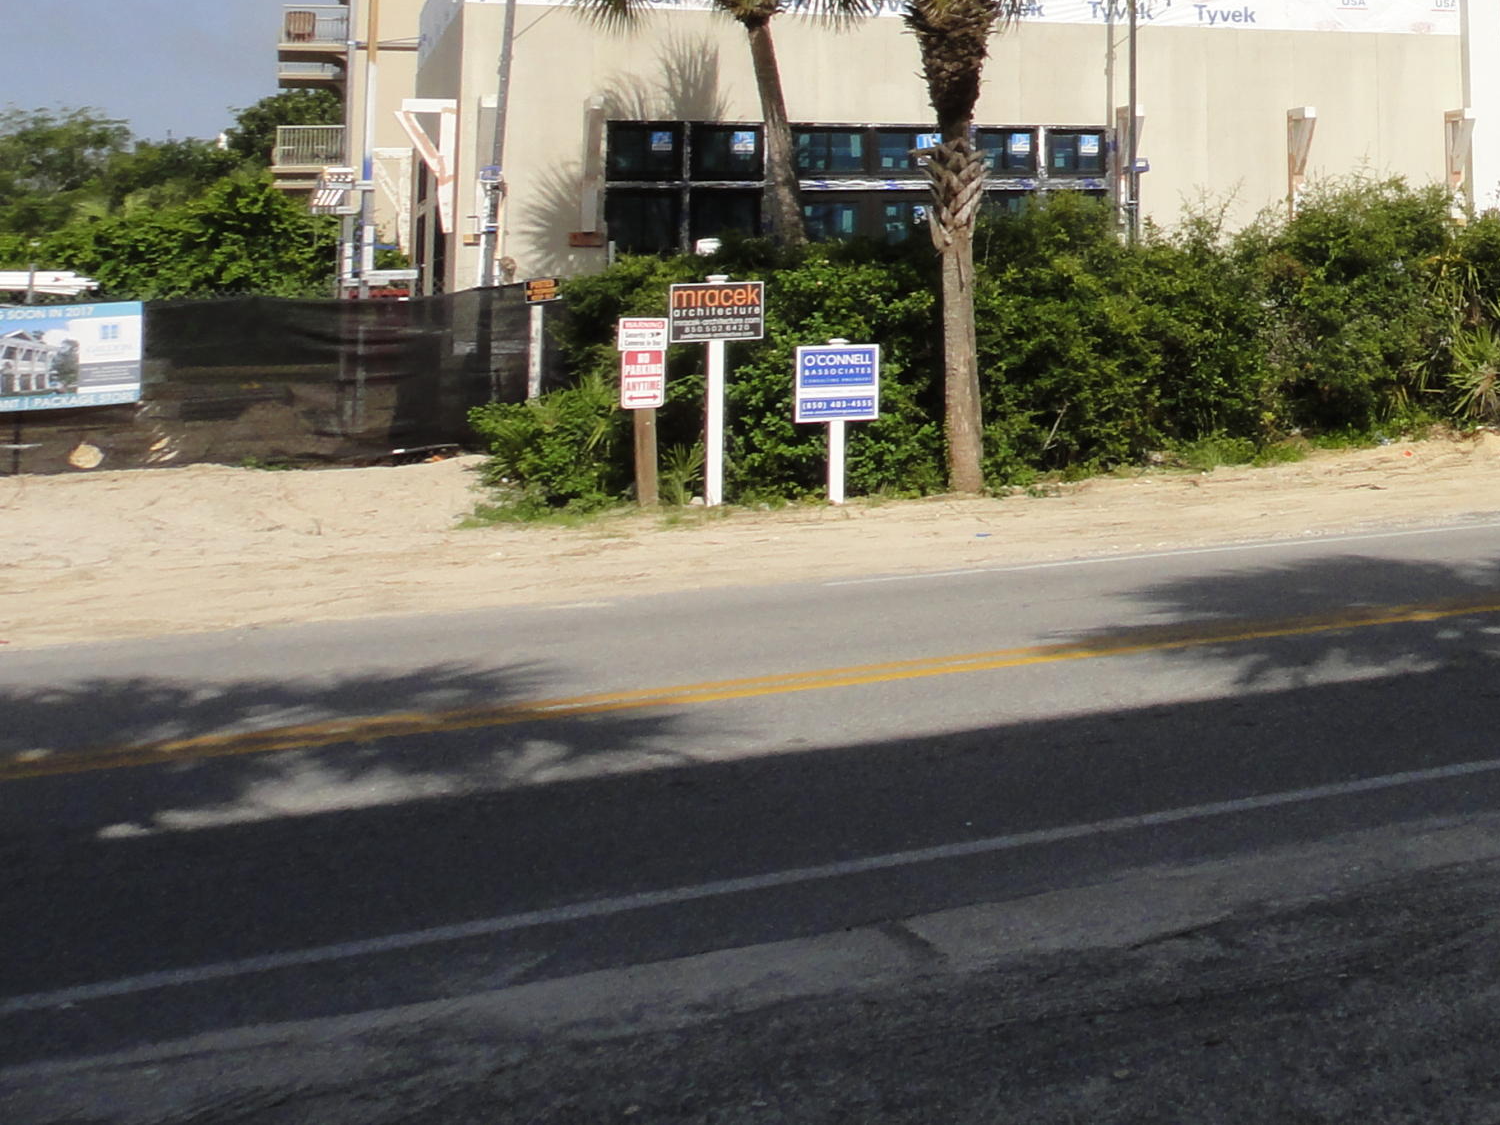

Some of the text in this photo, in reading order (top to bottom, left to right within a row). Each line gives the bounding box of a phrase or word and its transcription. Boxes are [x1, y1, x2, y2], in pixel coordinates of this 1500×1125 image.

[1193, 4, 1256, 25] Tyvek
[673, 285, 760, 307] mracek
[7, 309, 46, 320] SOON
[65, 306, 94, 317] 2017
[673, 306, 760, 317] architecture
[804, 354, 872, 366] O'CONNELL
[625, 380, 661, 391] ANYTIME
